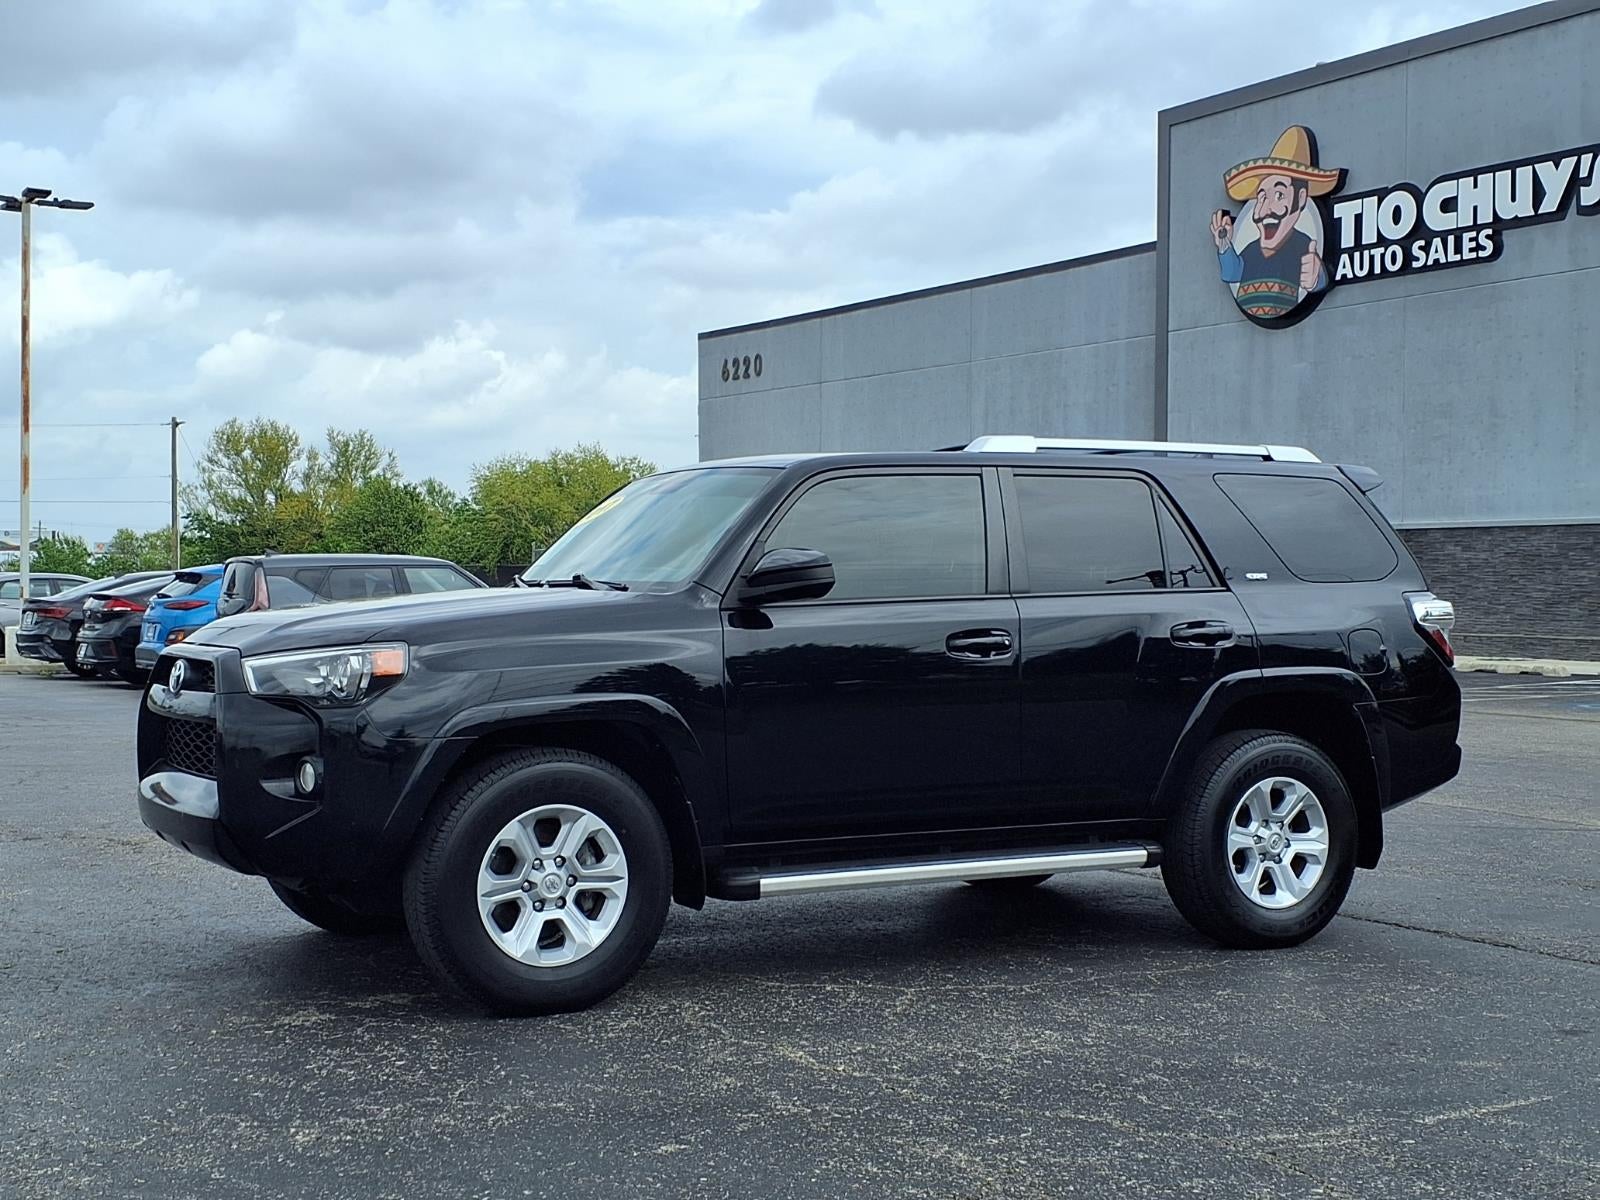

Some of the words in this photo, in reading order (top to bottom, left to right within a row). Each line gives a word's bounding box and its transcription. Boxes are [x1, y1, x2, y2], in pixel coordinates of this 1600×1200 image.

[1334, 189, 1417, 248] TIO
[1335, 244, 1404, 281] AUTO
[1412, 229, 1494, 268] SALES
[721, 353, 763, 383] 6220
